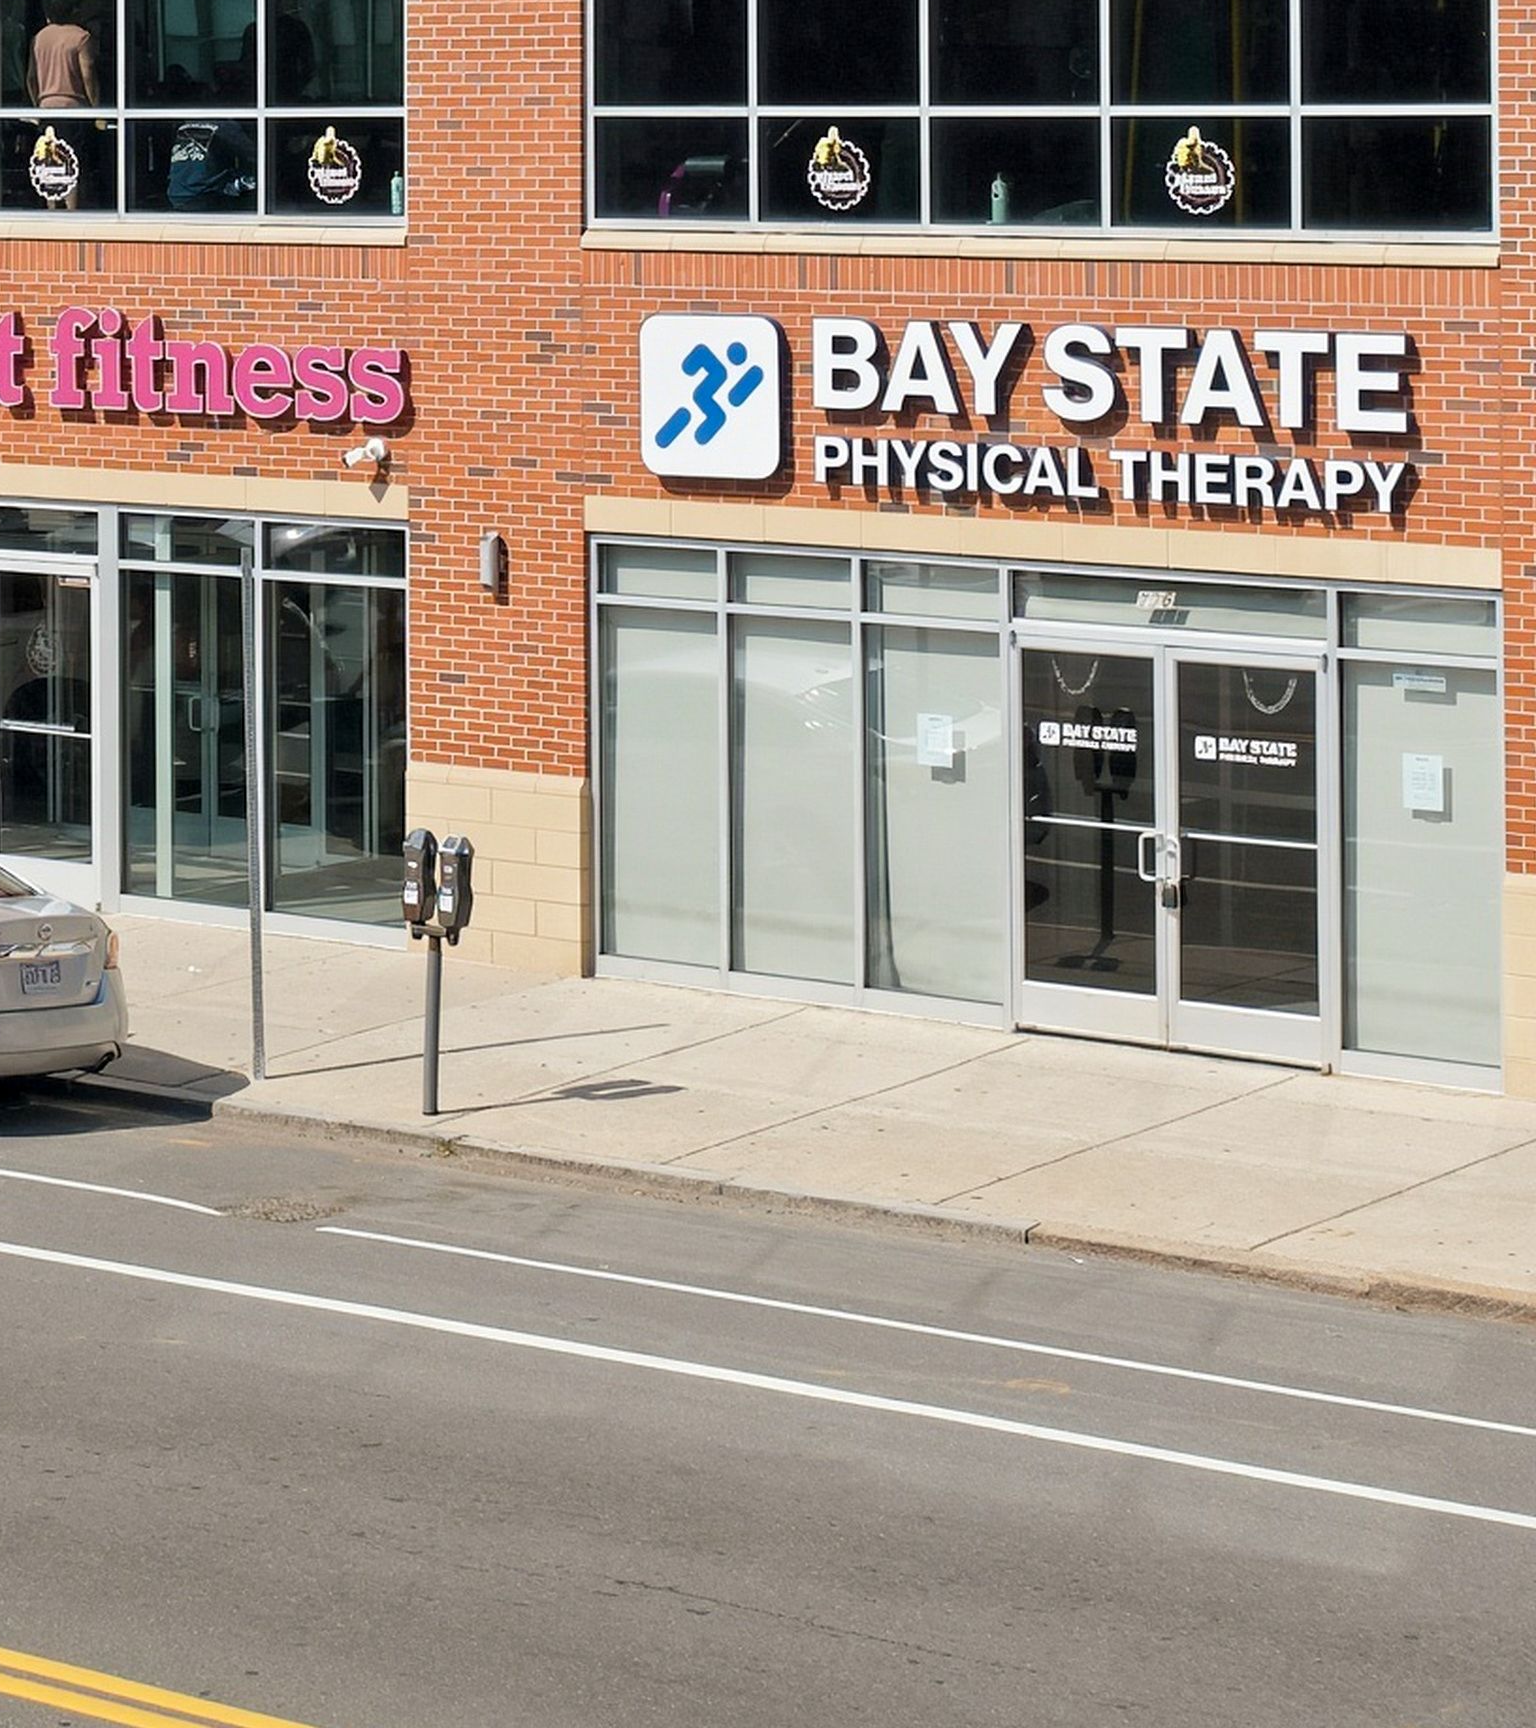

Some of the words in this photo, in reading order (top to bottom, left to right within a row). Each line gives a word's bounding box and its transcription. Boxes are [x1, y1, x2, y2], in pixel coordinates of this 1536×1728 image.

[49, 305, 405, 424] fitness
[812, 317, 1023, 416] BAY
[1041, 323, 1408, 434] STATE
[813, 435, 1100, 499] PHYSICAL
[1108, 449, 1406, 513] THERAPY
[1092, 726, 1138, 743] STATE
[1250, 740, 1298, 757] STATE
